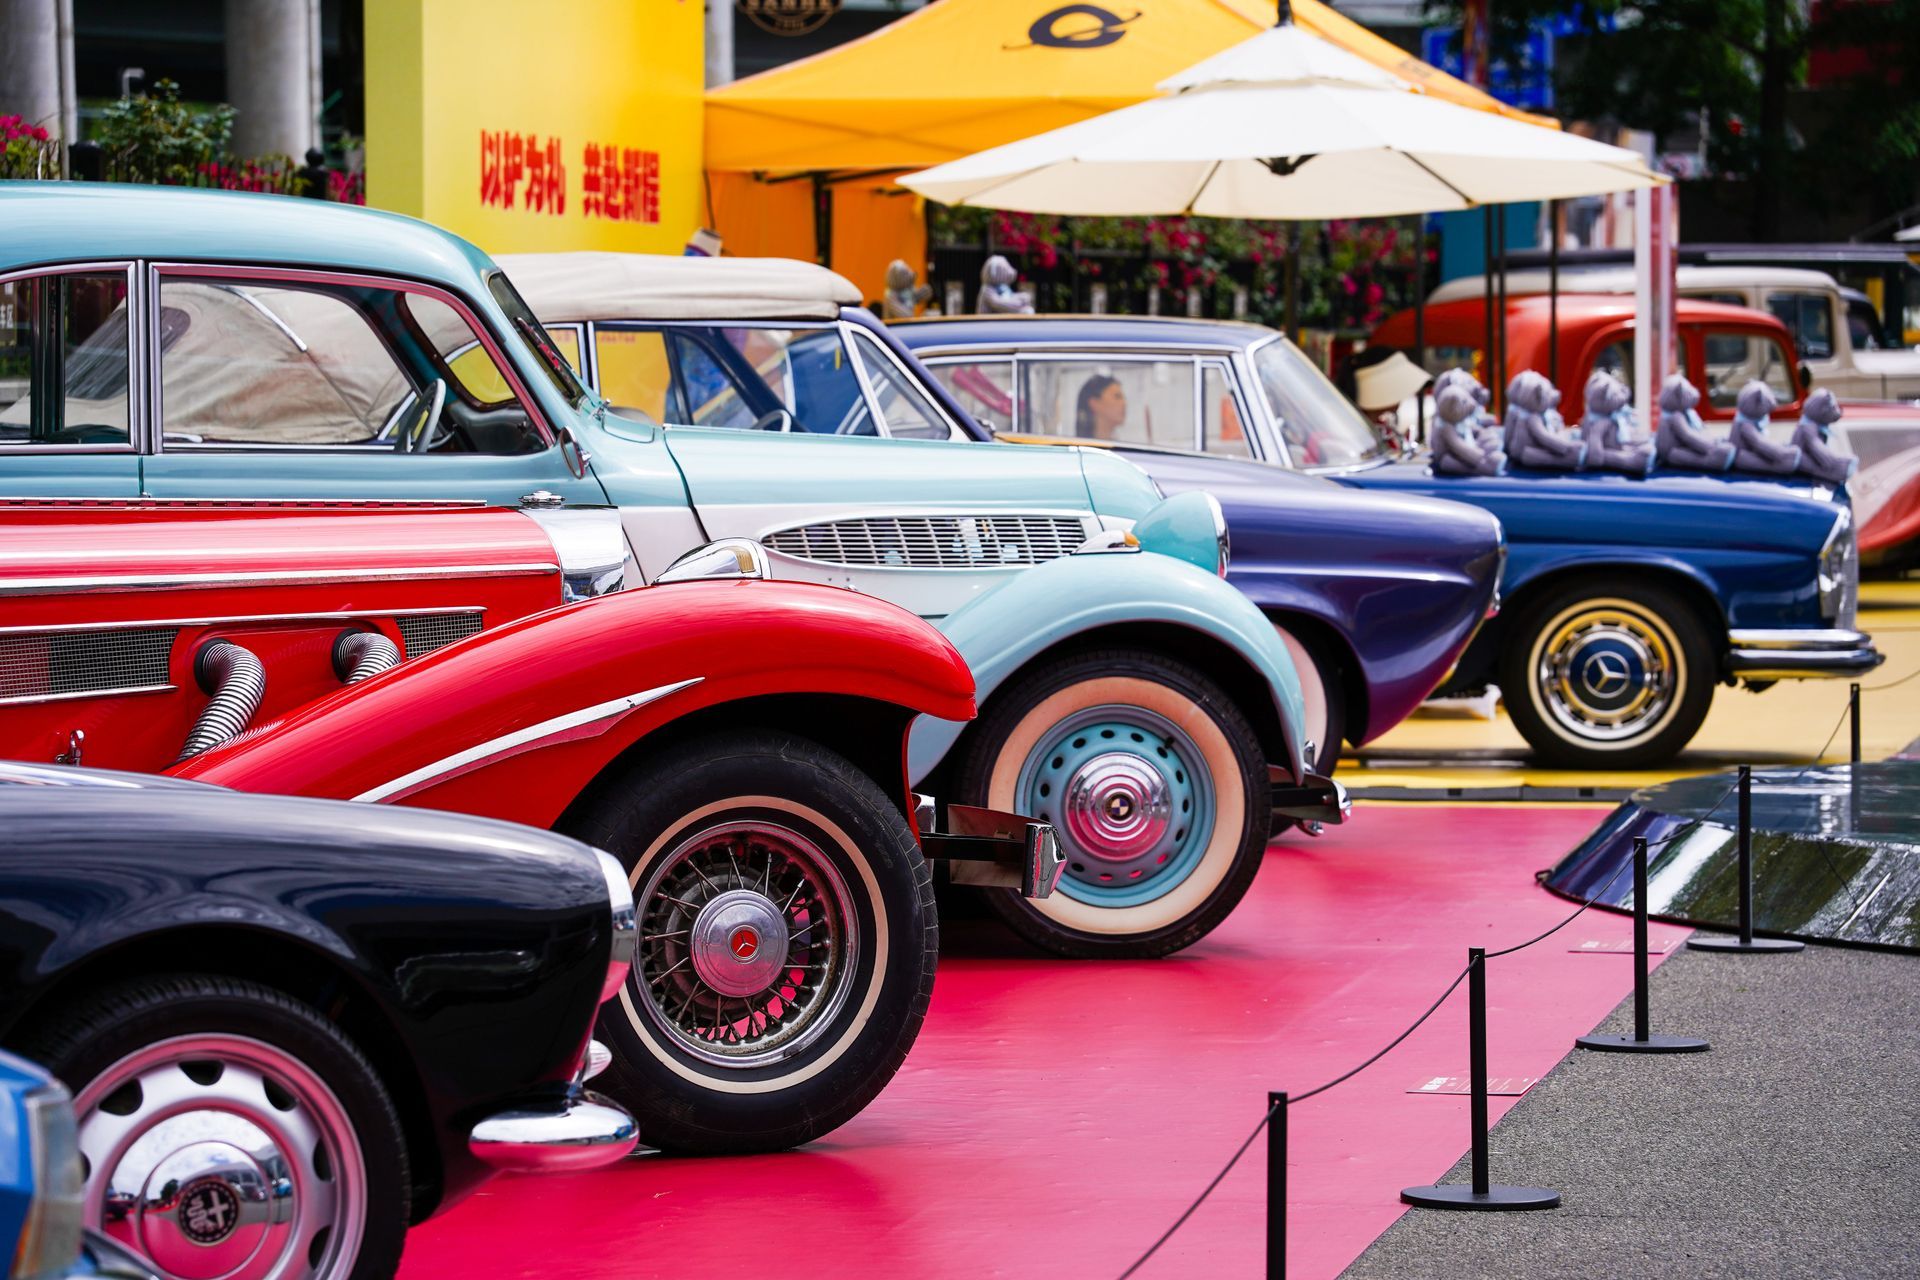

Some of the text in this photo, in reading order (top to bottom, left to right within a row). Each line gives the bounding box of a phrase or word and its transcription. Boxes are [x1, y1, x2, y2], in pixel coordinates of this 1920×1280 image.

[480, 130, 660, 224] 以护为礼 共赴新程
